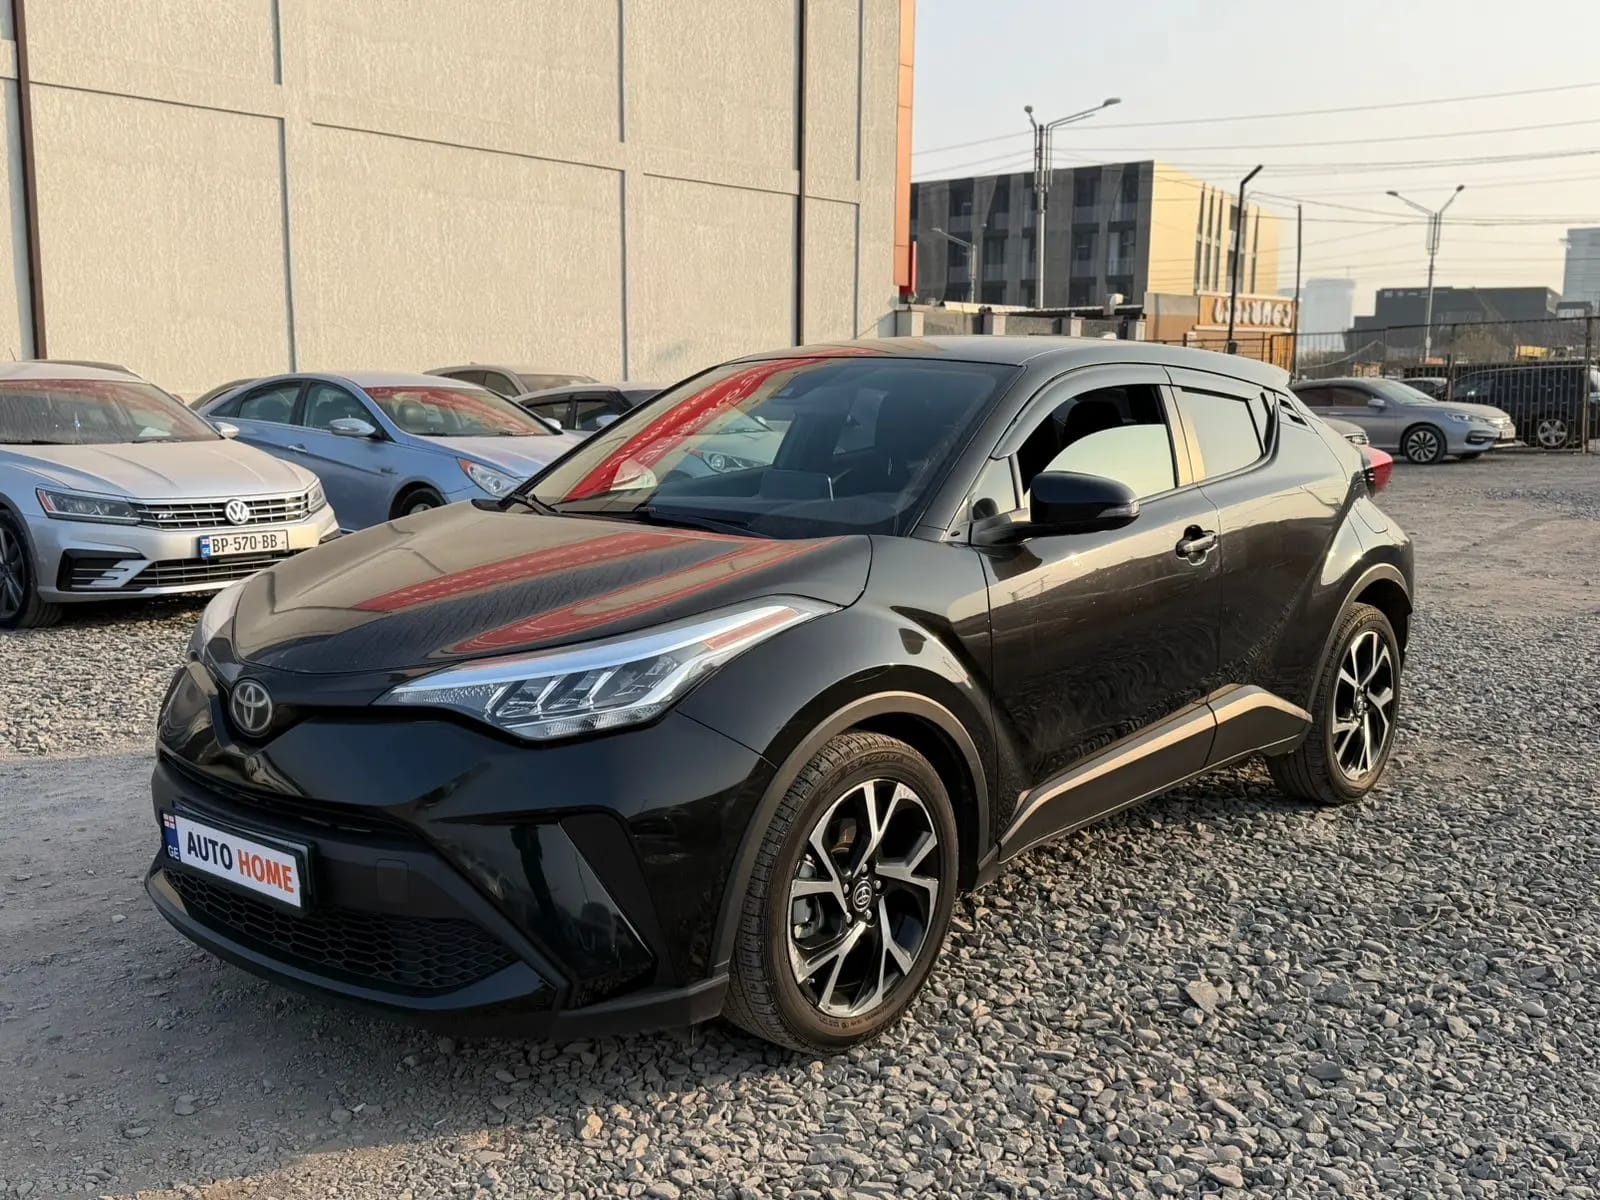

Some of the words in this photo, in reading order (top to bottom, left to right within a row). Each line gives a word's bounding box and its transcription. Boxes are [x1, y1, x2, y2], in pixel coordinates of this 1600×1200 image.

[167, 844, 180, 860] GE
[187, 831, 233, 870] AUTO
[237, 849, 294, 893] HOME
